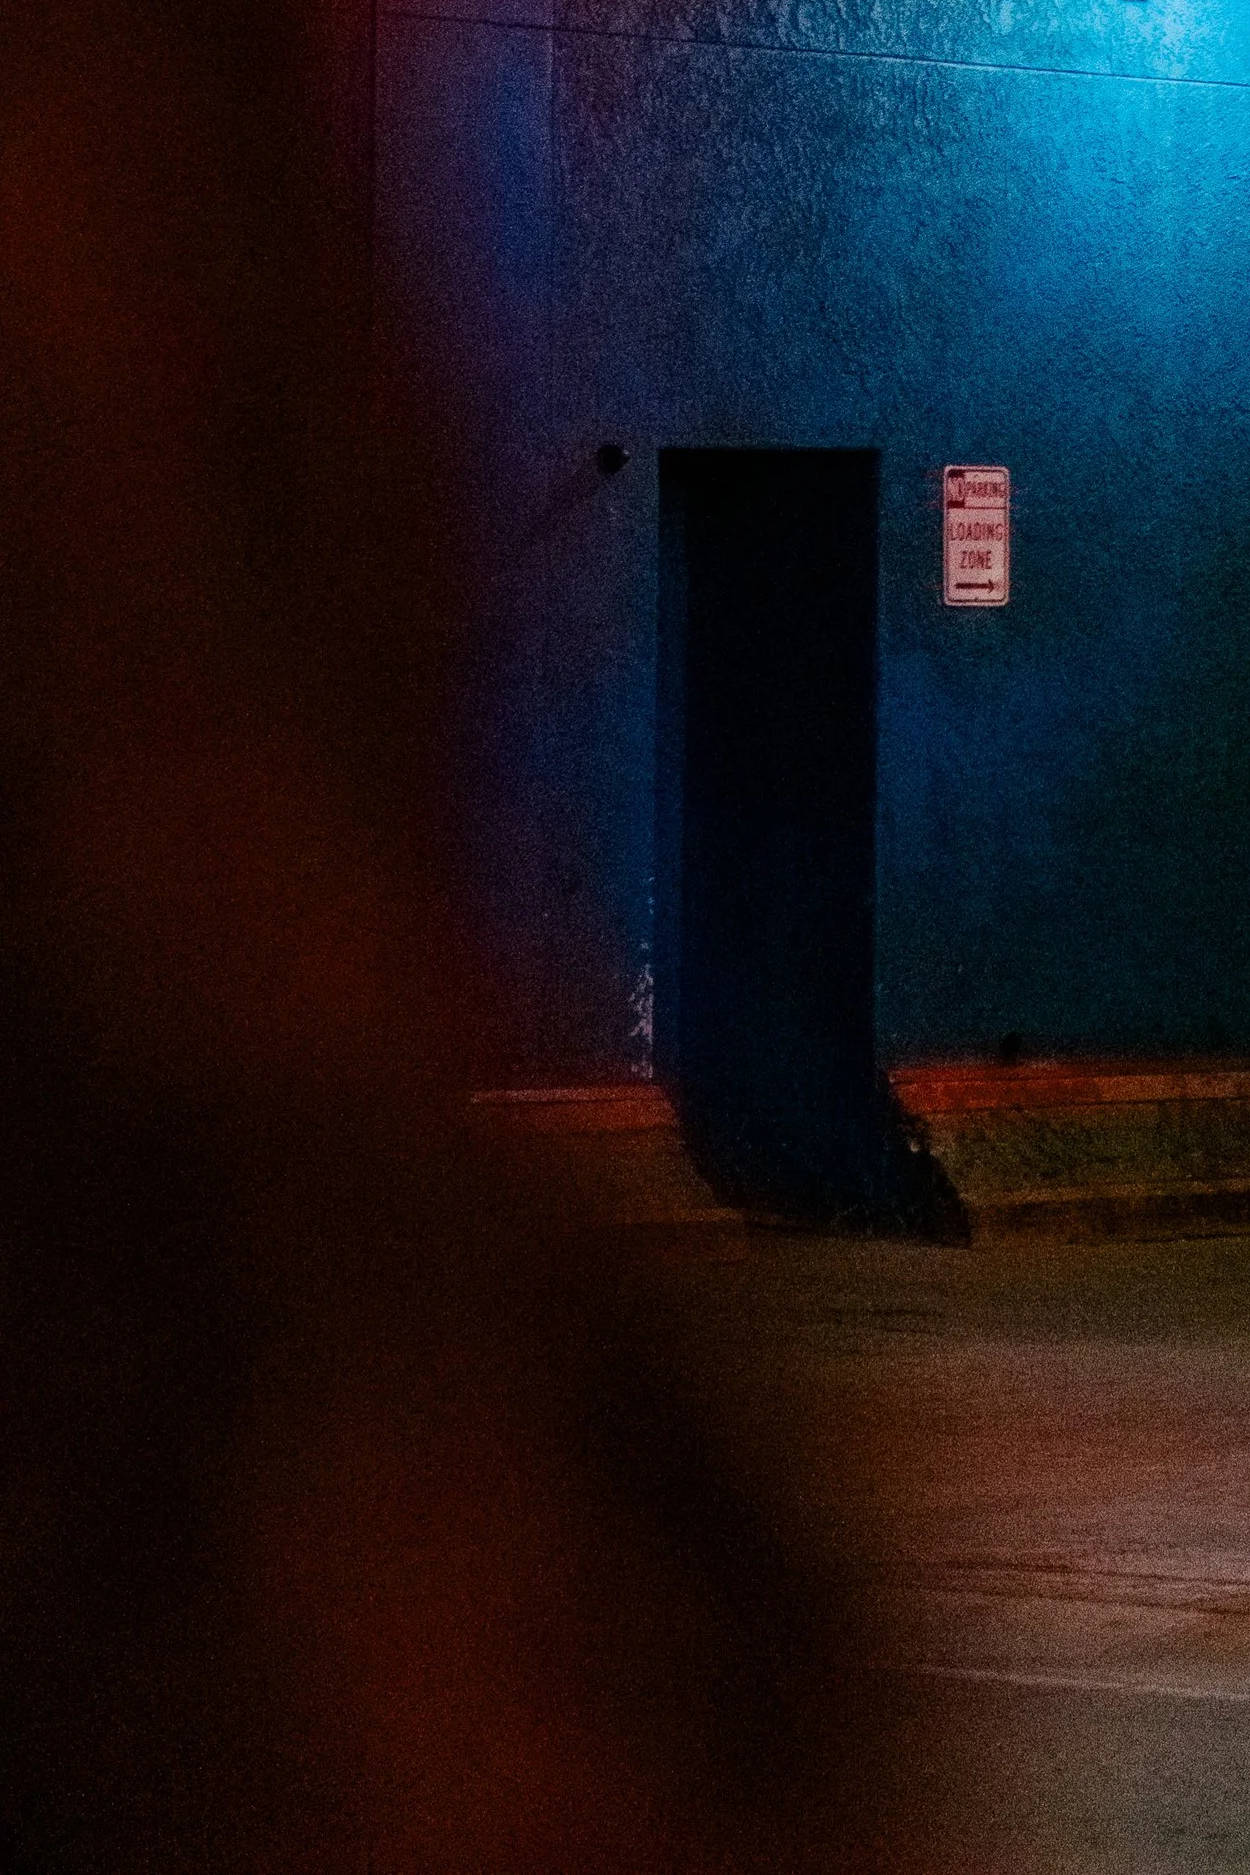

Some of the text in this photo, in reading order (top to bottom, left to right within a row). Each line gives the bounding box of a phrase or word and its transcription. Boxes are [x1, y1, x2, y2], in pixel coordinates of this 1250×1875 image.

[948, 477, 964, 501] NO
[950, 522, 1003, 541] LOADING
[960, 550, 993, 570] ZONE
